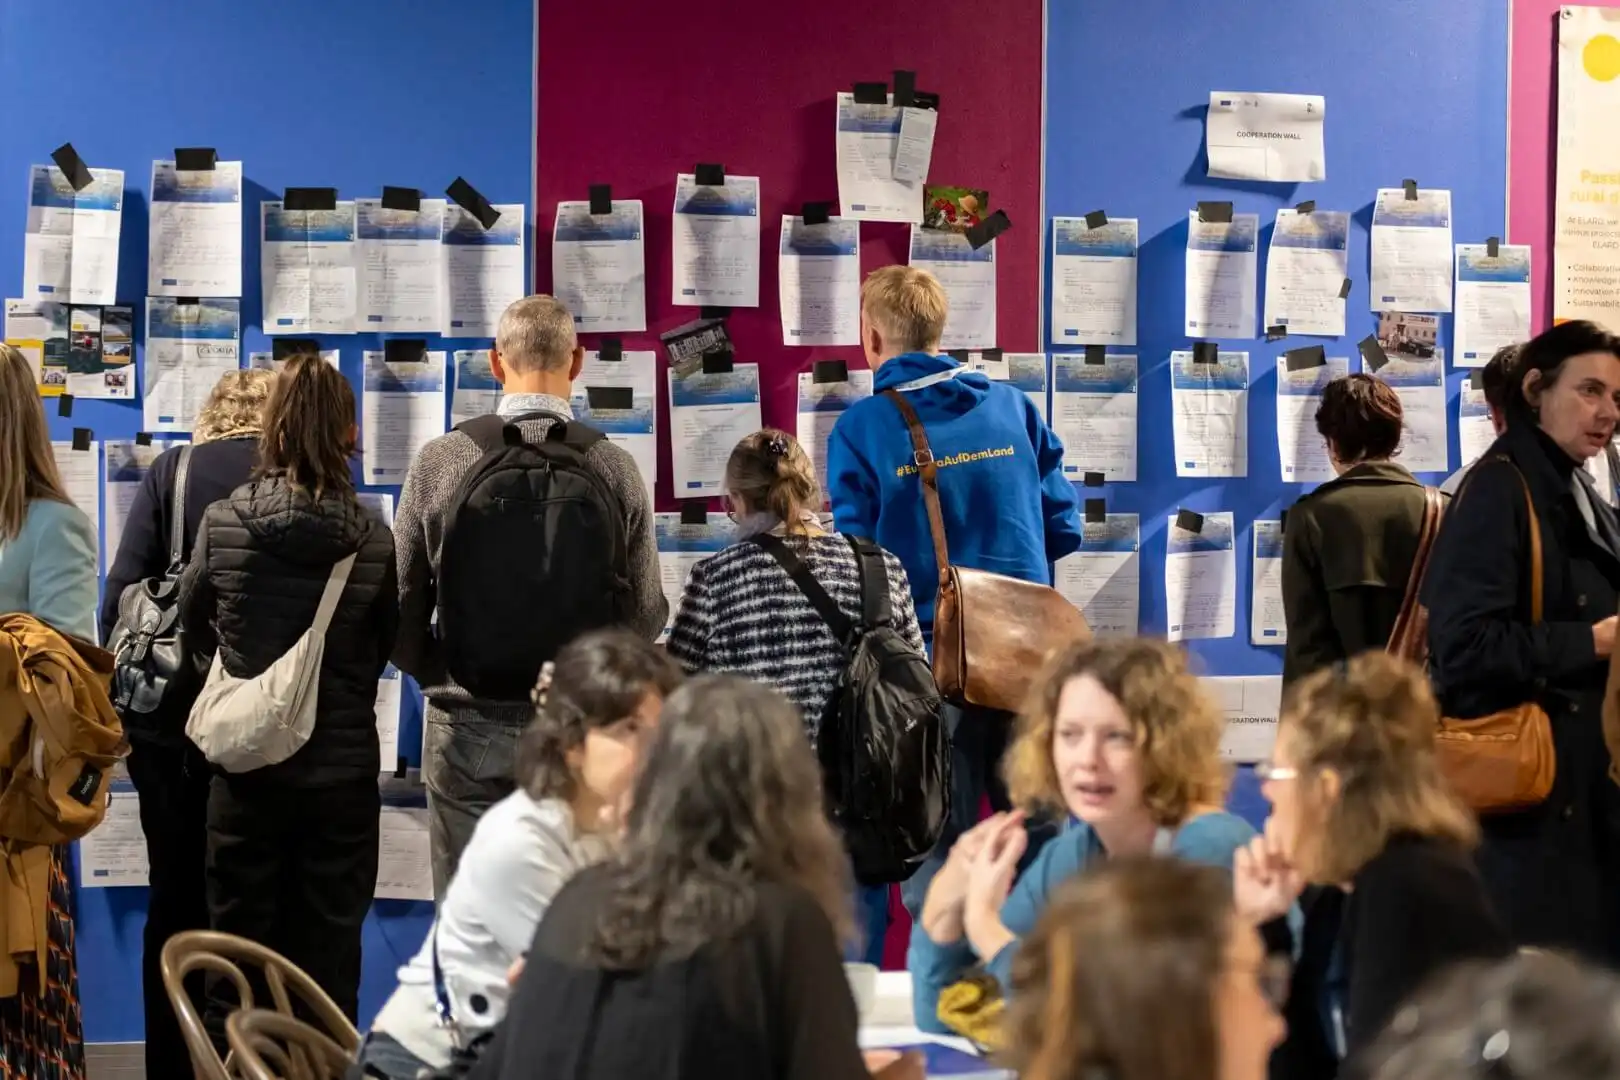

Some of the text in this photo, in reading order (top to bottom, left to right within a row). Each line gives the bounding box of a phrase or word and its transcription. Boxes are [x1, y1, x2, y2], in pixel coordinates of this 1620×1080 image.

[1236, 130, 1302, 140] COOPERATION WALL
[1592, 240, 1619, 250] ELARD
[896, 444, 1015, 477] #EuaAufDemLand
